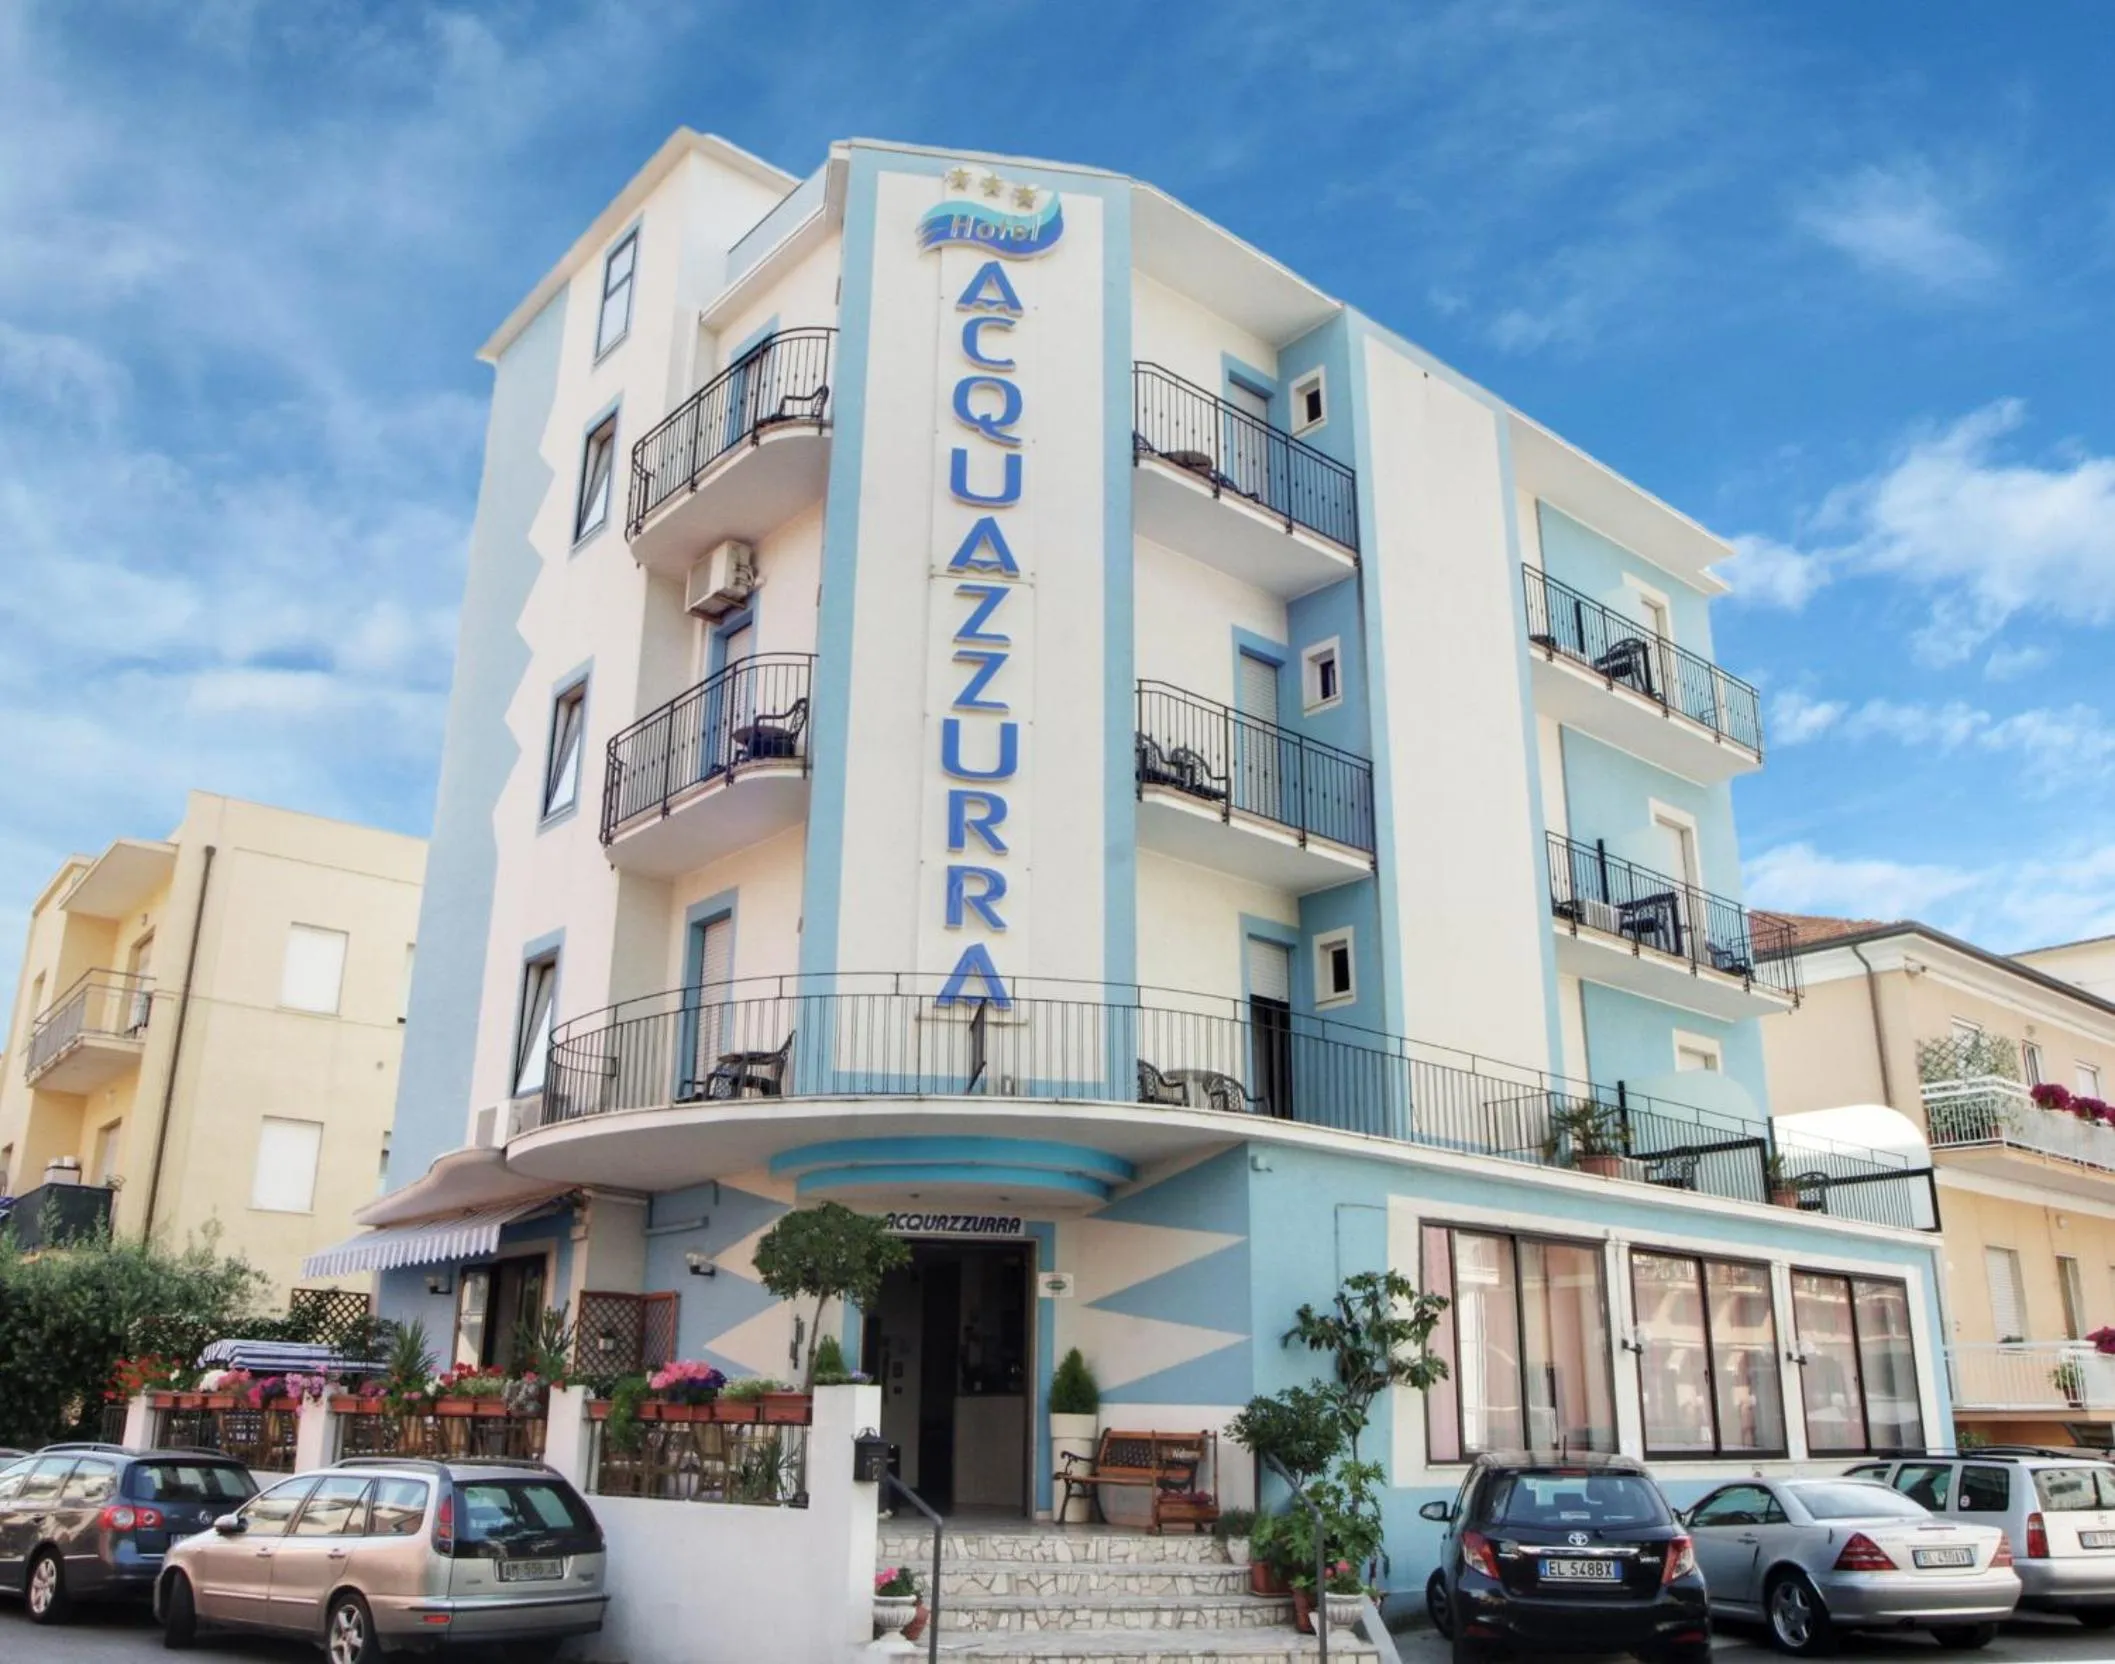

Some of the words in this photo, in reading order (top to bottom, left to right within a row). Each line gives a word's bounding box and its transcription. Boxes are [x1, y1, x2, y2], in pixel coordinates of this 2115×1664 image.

[949, 214, 1041, 241] Hotel
[934, 260, 1023, 1012] ACQUAZZURRA
[886, 1212, 1021, 1234] ACQUAZZURRA
